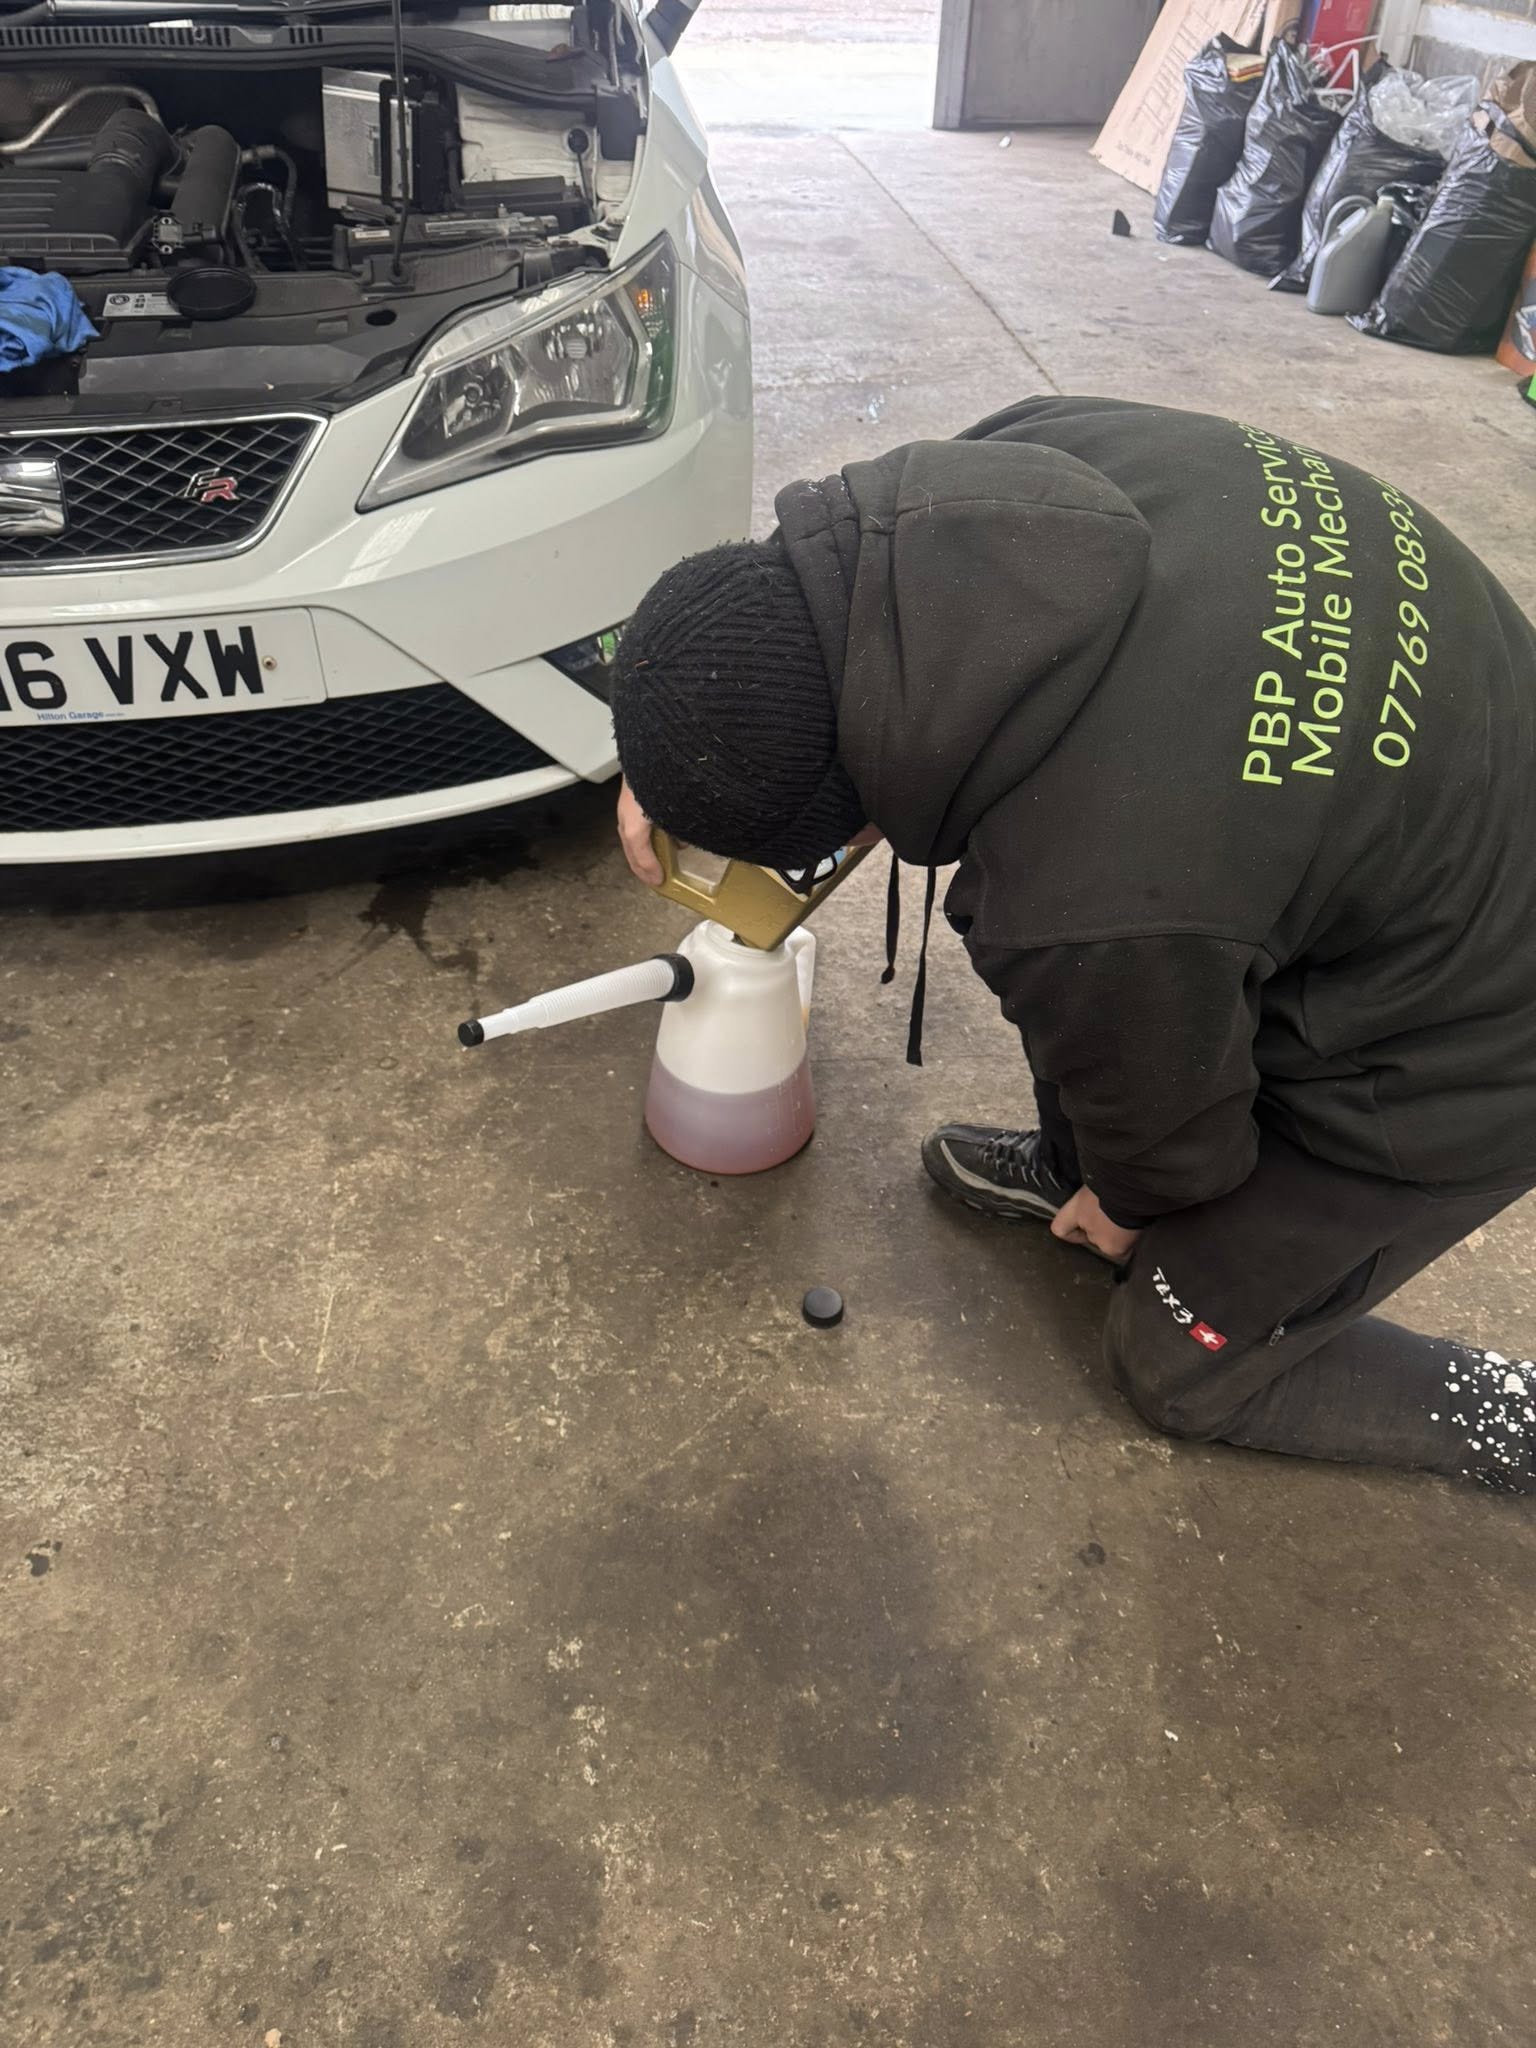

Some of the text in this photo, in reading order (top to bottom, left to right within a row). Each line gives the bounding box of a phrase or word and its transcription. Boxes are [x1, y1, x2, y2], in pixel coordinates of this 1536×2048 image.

[183, 467, 240, 503] FR
[1262, 543, 1306, 660] Auto
[68, 711, 104, 720] Garage
[83, 625, 264, 706] VXW
[1291, 593, 1352, 776] Mobile
[1372, 600, 1430, 768] 07769
[1242, 671, 1296, 785] PBP
